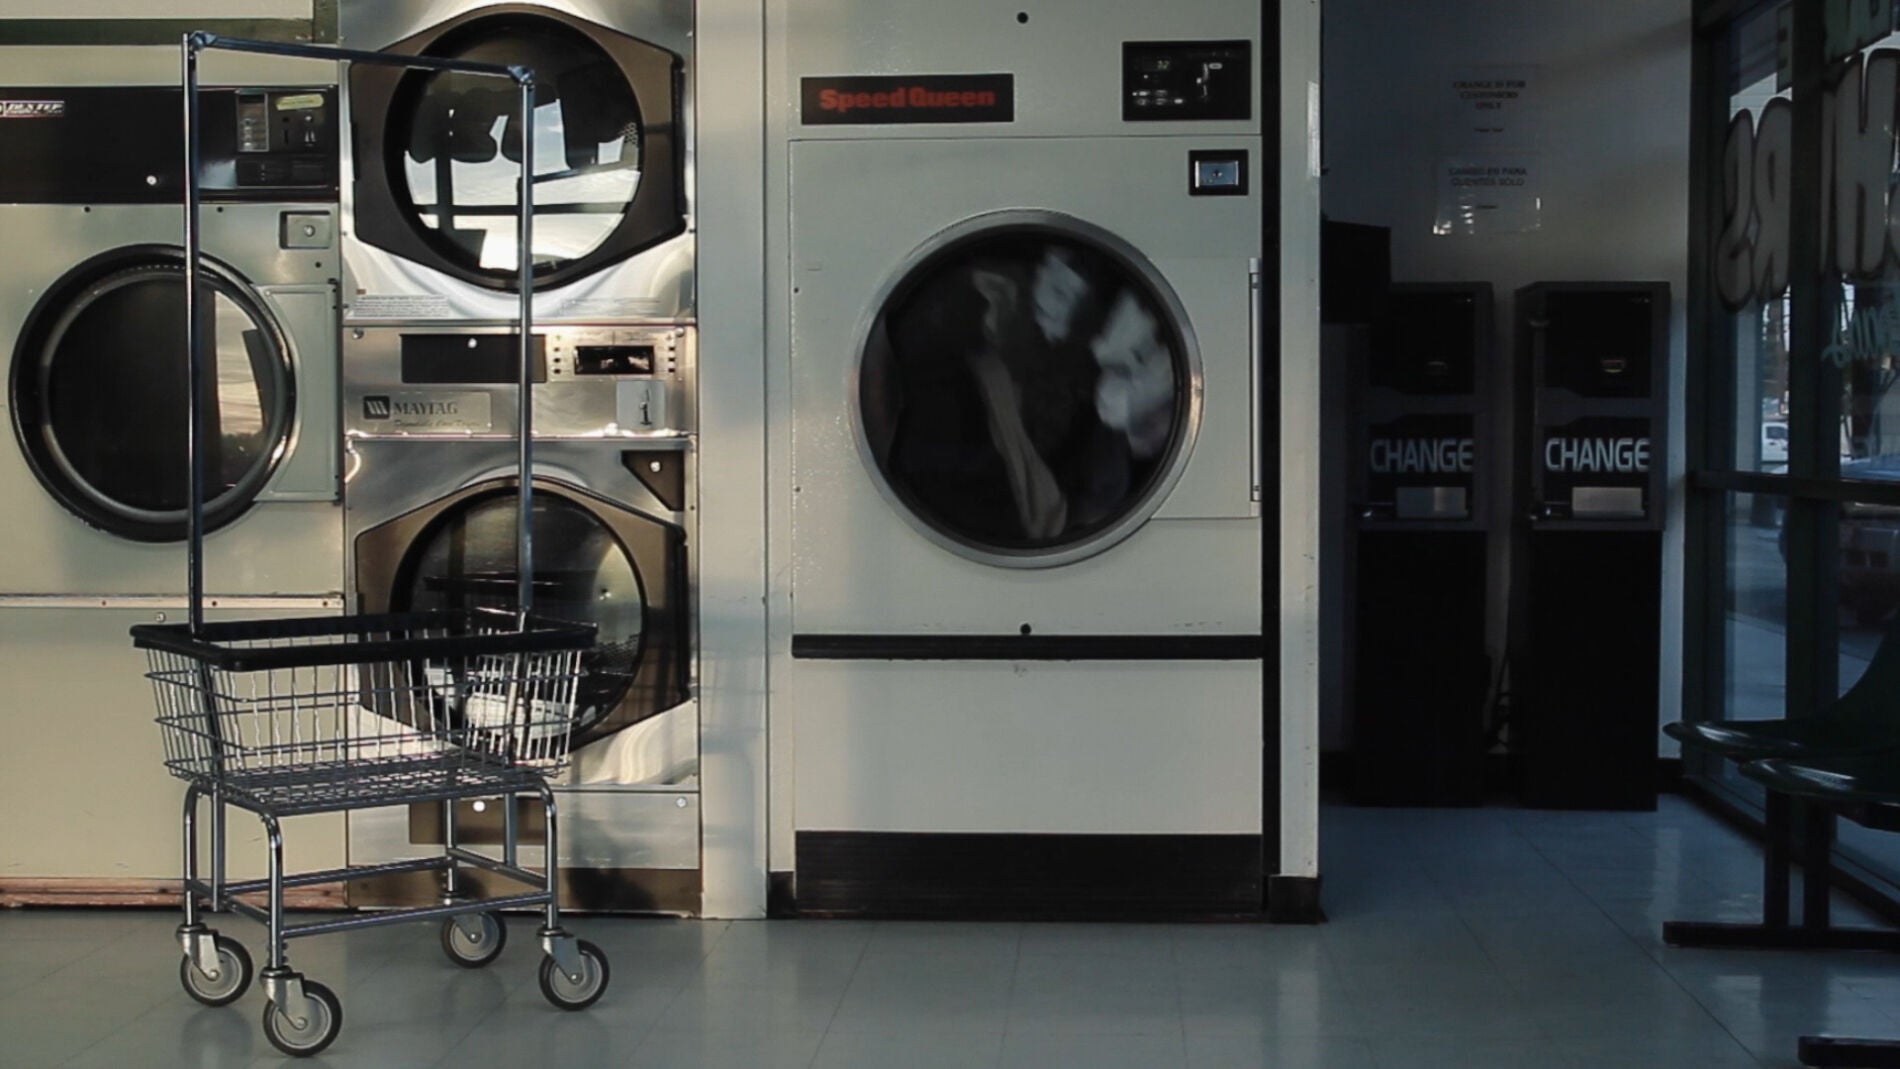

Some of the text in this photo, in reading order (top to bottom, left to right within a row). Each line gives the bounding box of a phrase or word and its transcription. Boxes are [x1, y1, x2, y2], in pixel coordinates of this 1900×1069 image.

[818, 86, 997, 114] Speed Queen
[393, 402, 458, 415] MAYTAG
[1369, 437, 1474, 473] CHANGE
[1544, 437, 1651, 473] CHANGE
